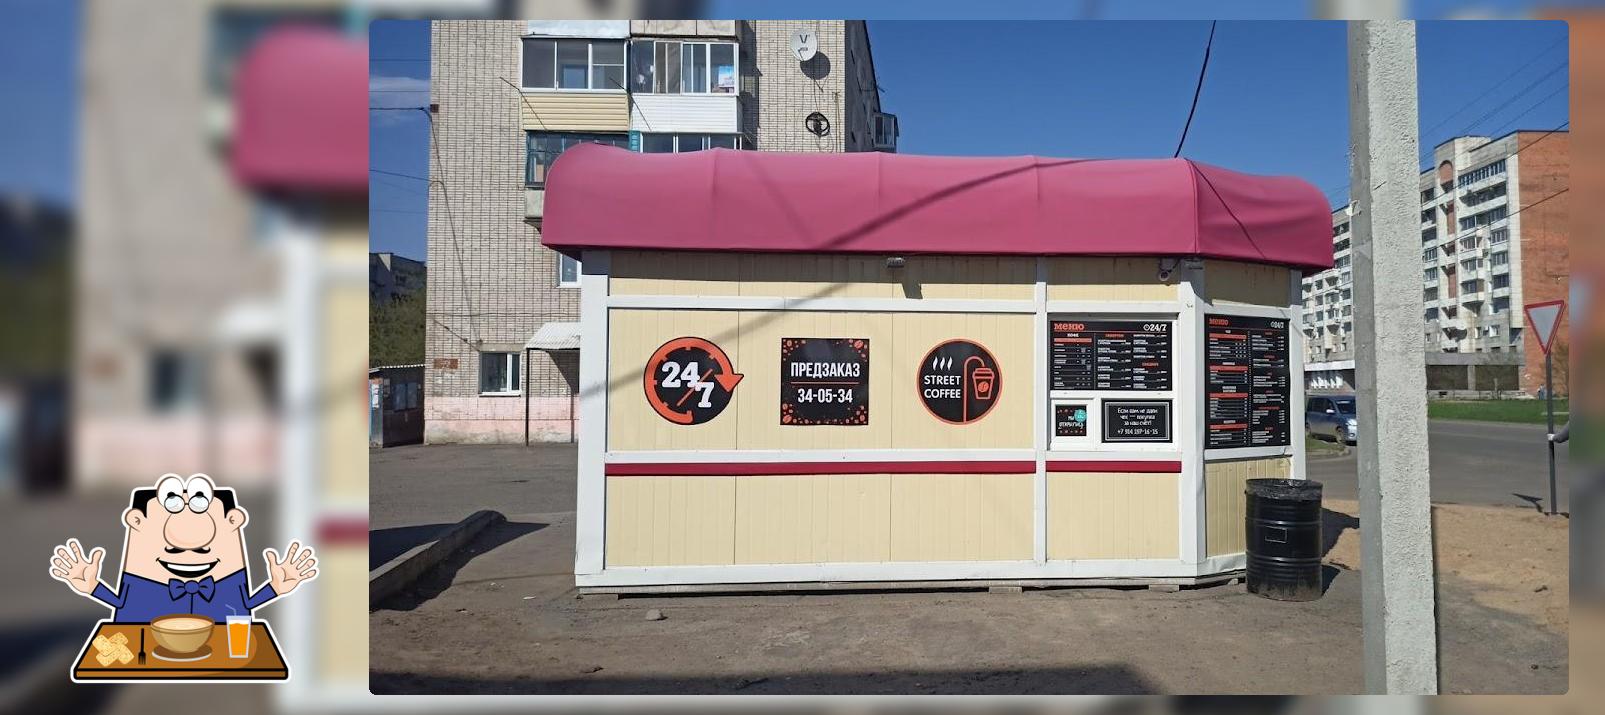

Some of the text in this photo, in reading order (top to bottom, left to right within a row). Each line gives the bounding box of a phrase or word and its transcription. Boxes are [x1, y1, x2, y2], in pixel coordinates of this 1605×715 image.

[1150, 324, 1168, 332] 24/7
[790, 362, 861, 379] ПРЕДЗАКАЗ
[924, 375, 961, 386] STREET
[797, 388, 853, 404] 34-05-34
[924, 389, 961, 399] COFFEE
